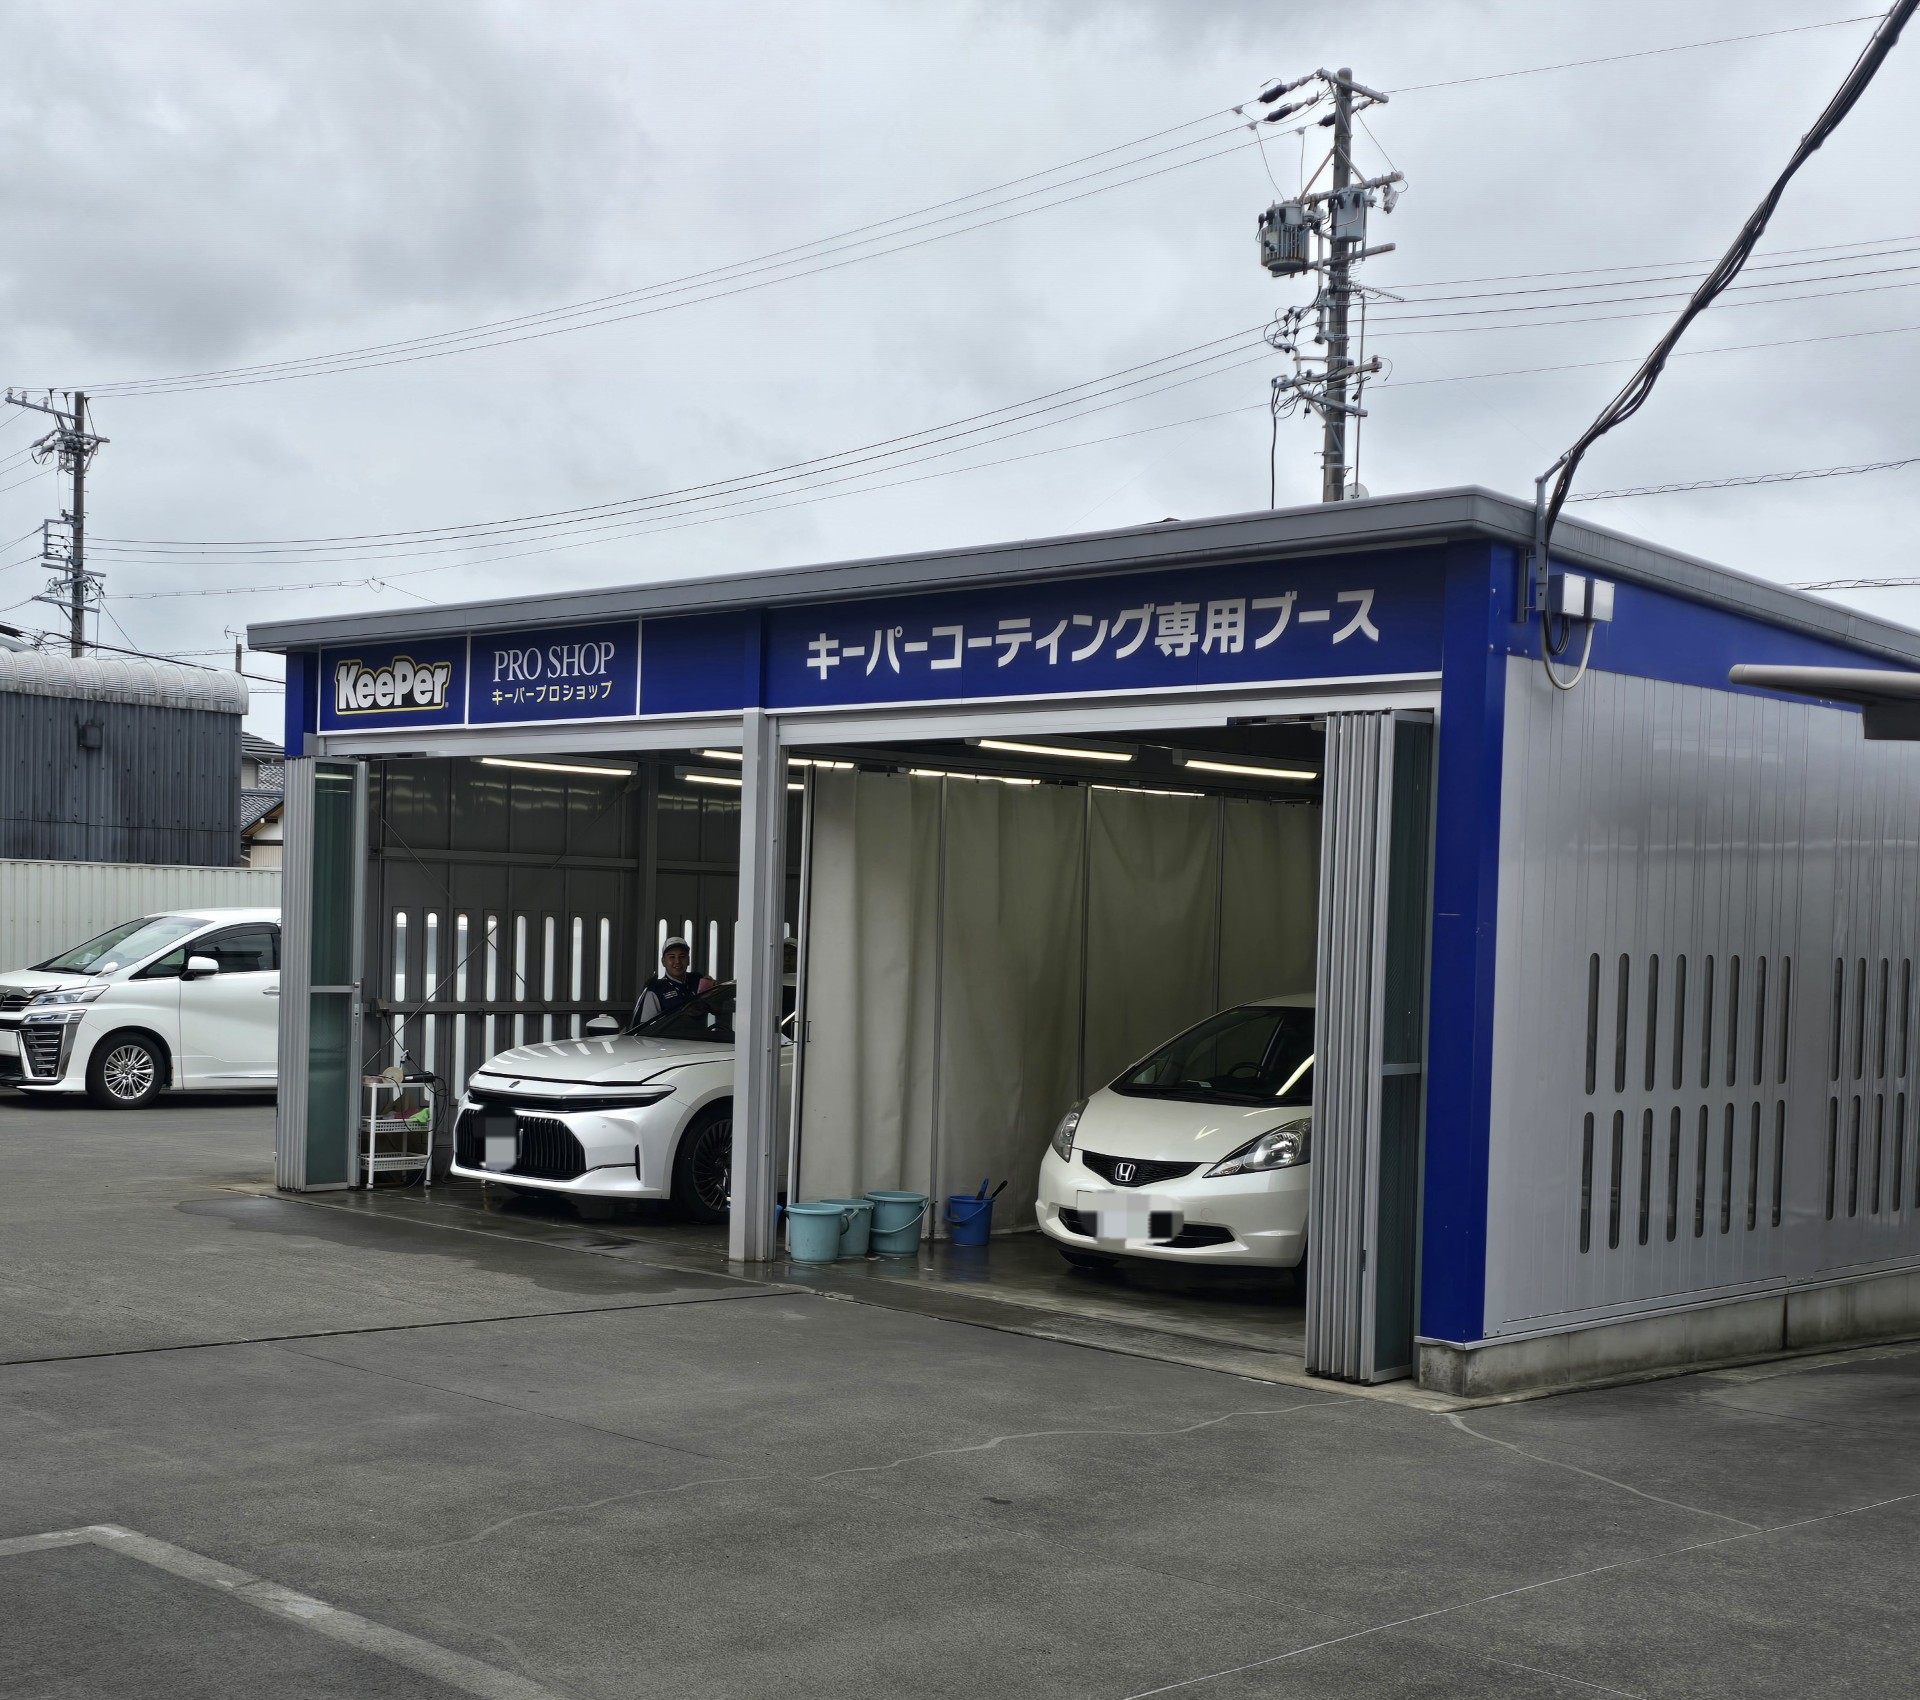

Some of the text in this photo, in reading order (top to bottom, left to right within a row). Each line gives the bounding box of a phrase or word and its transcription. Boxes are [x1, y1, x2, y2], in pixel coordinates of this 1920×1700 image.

[806, 588, 1380, 680] キーパーコーティング専用ブース
[493, 641, 615, 682] PRO SHOP
[336, 659, 449, 711] KeePer
[491, 680, 613, 706] キーパープロショップ
